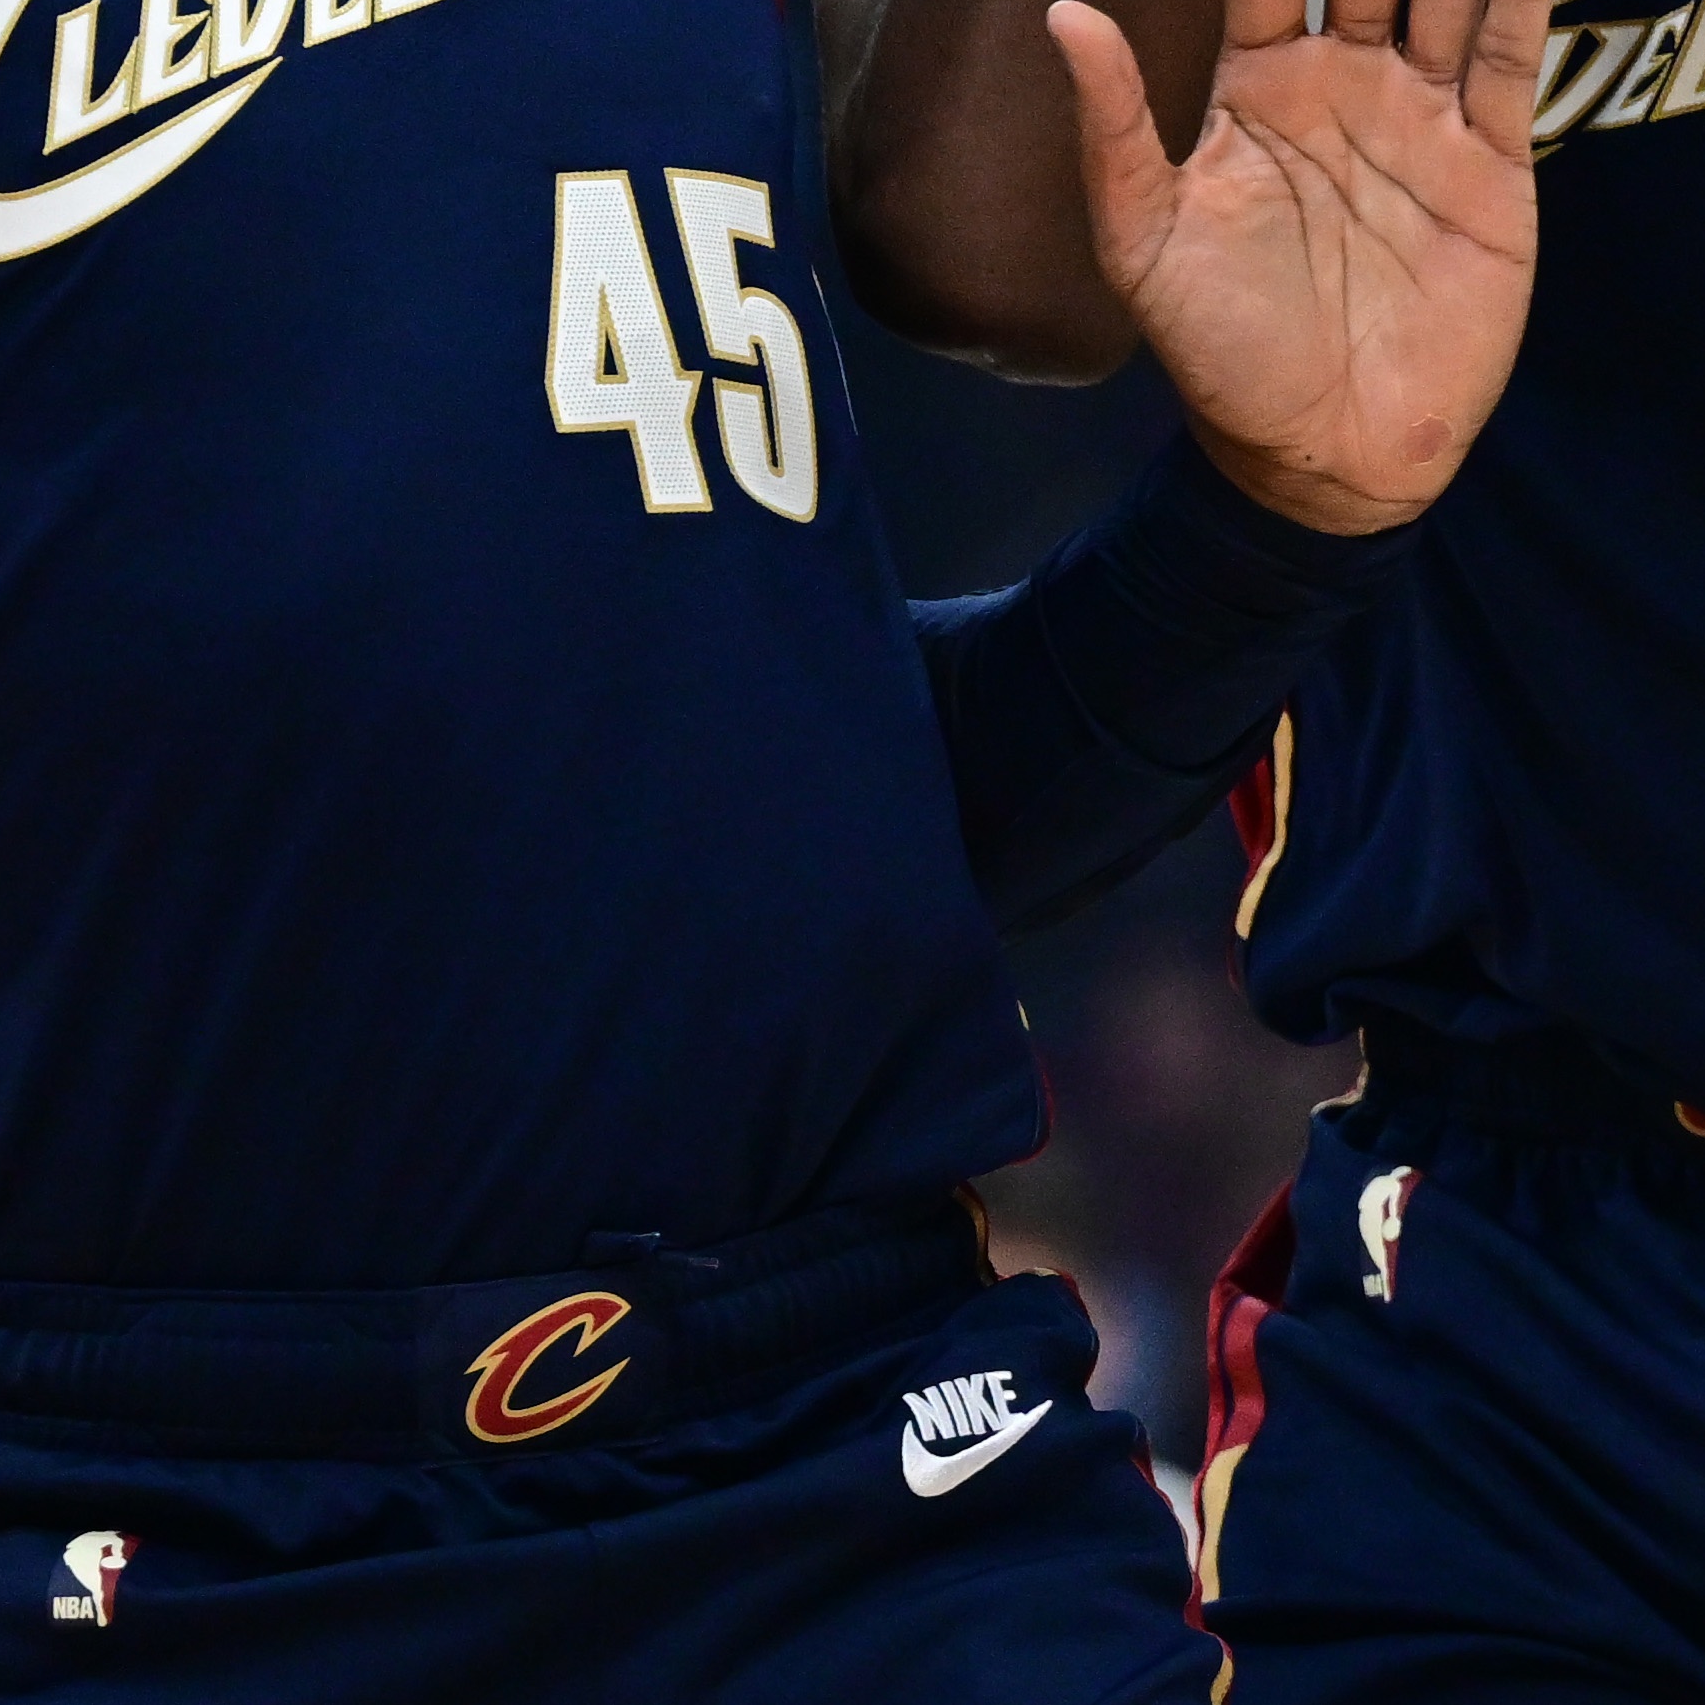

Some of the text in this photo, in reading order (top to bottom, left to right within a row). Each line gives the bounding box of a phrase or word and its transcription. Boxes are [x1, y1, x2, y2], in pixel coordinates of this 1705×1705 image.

[545, 167, 819, 524] 45
[463, 1291, 632, 1443] C
[902, 1371, 1026, 1442] NIKE
[53, 1596, 95, 1619] NBA
